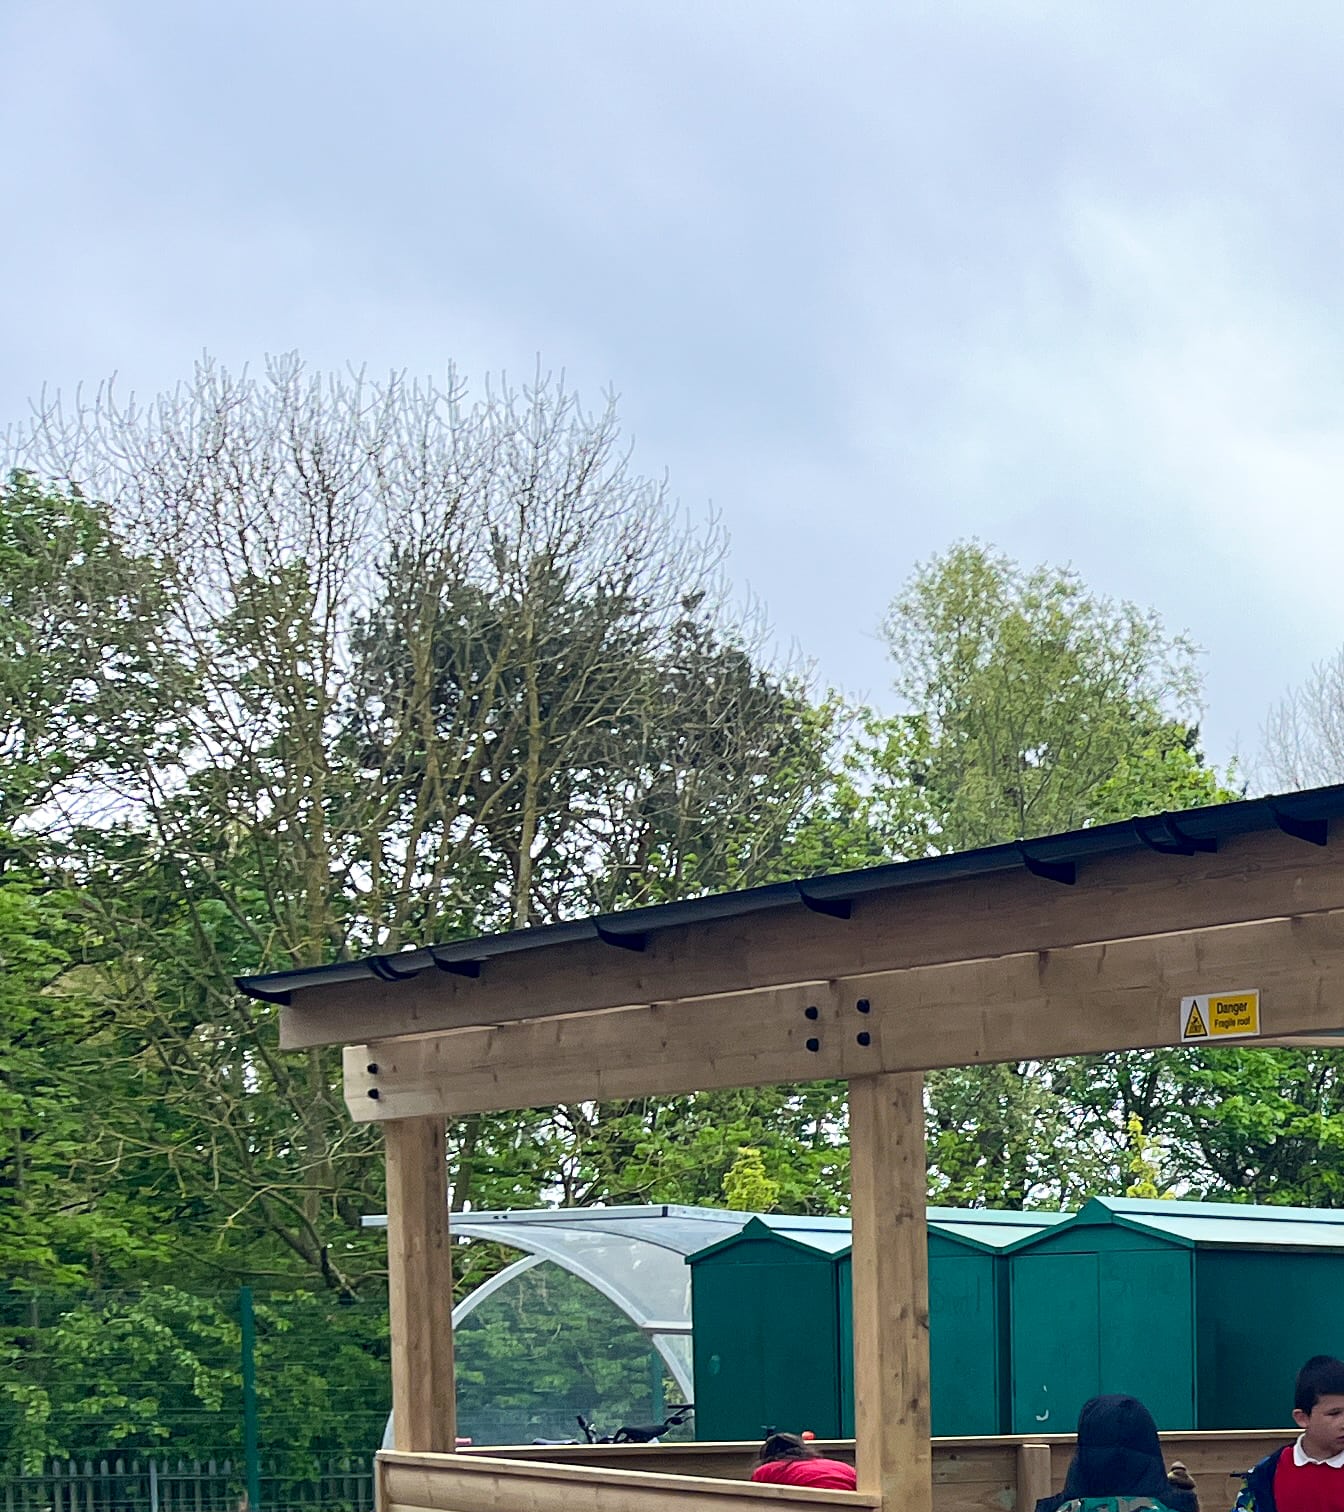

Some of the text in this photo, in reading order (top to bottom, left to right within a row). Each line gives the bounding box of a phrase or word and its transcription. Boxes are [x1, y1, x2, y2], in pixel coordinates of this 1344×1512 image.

[1216, 1002, 1248, 1015] Danger
[1214, 1016, 1251, 1029] Fragile roof
